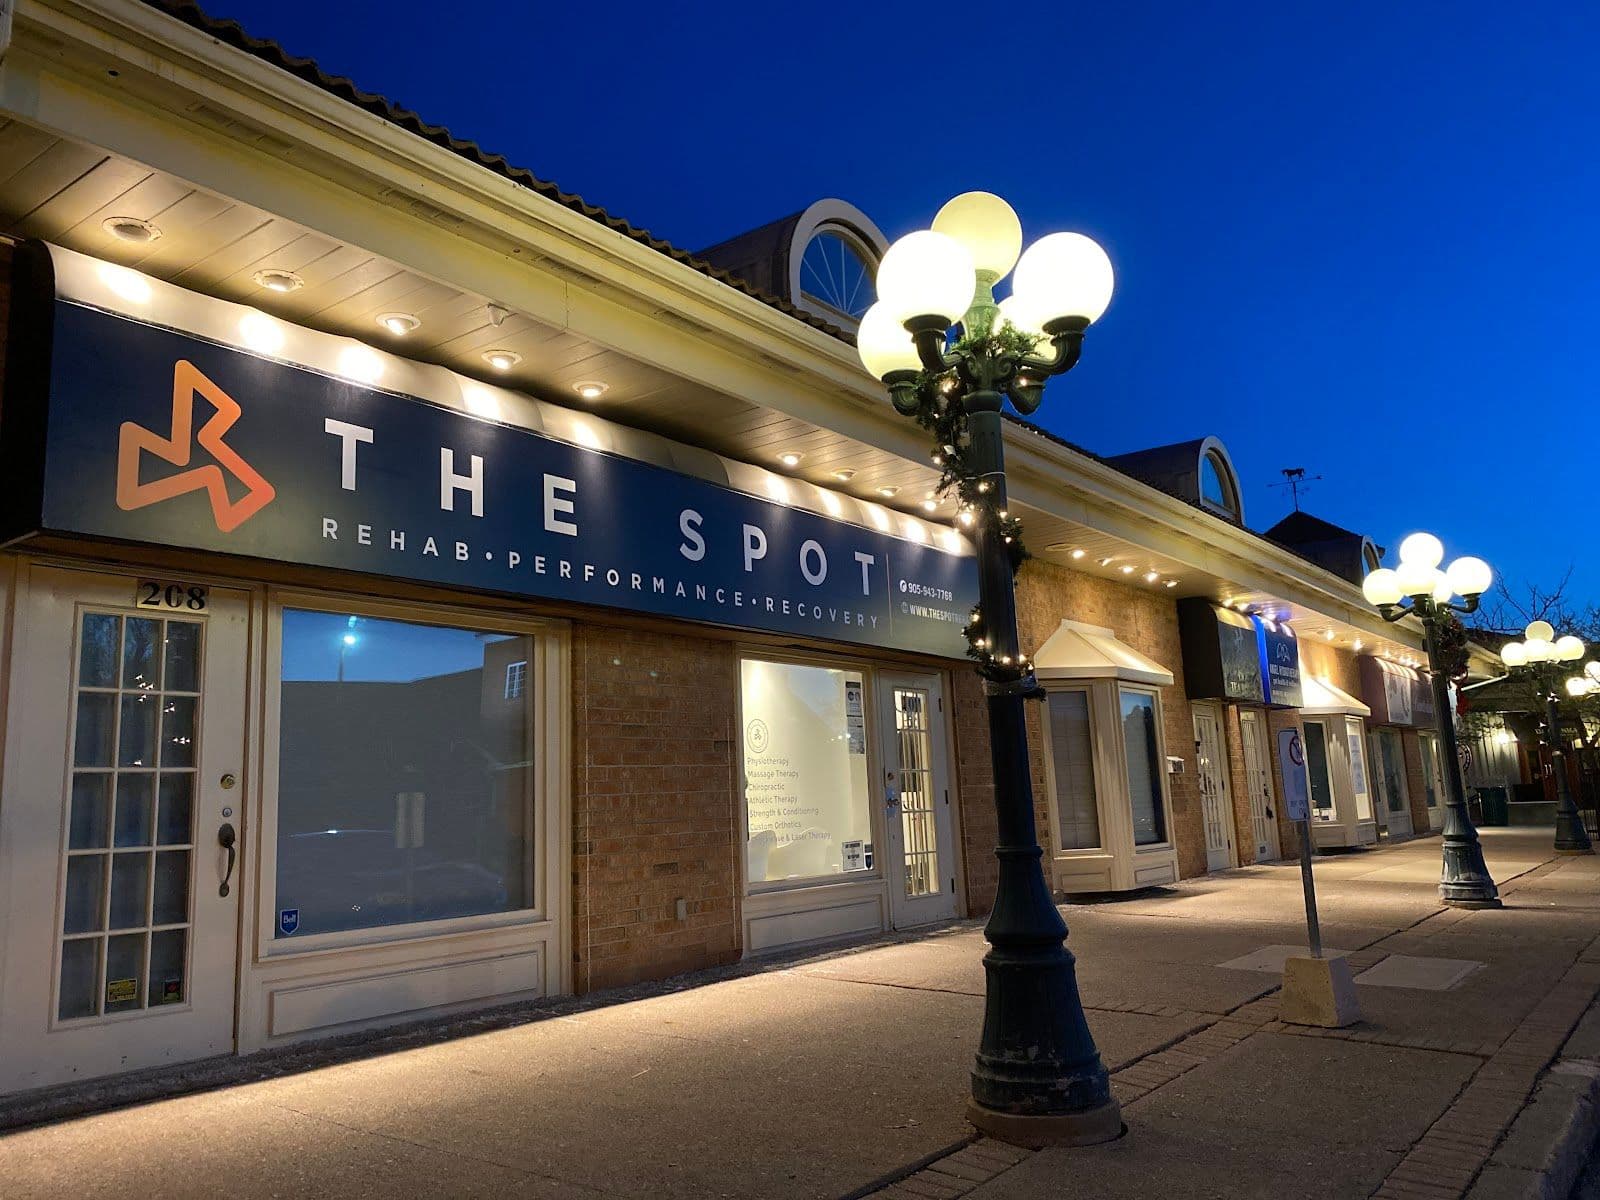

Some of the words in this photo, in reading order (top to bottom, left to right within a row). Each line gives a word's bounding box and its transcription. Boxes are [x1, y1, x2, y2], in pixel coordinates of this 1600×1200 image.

[324, 417, 578, 537] THE
[679, 508, 875, 596] SPOT
[322, 517, 469, 561] REHAB
[508, 551, 743, 607] PERFORMANCE
[765, 596, 878, 629] RECOVERY
[141, 582, 205, 610] 208
[747, 757, 789, 766] Physiotherapy
[748, 770, 775, 778] Massage
[776, 769, 799, 778] Therapy
[748, 783, 785, 791] Chiropractic
[749, 796, 773, 804] Athletic
[774, 795, 798, 804] Therapy
[750, 809, 776, 818] Strength
[783, 807, 819, 816] Conditioning
[750, 823, 774, 831] Custom
[775, 820, 801, 829] Orthotics
[791, 832, 807, 840] Laser
[808, 831, 831, 840] Therapy
[283, 914, 297, 924] Bell
